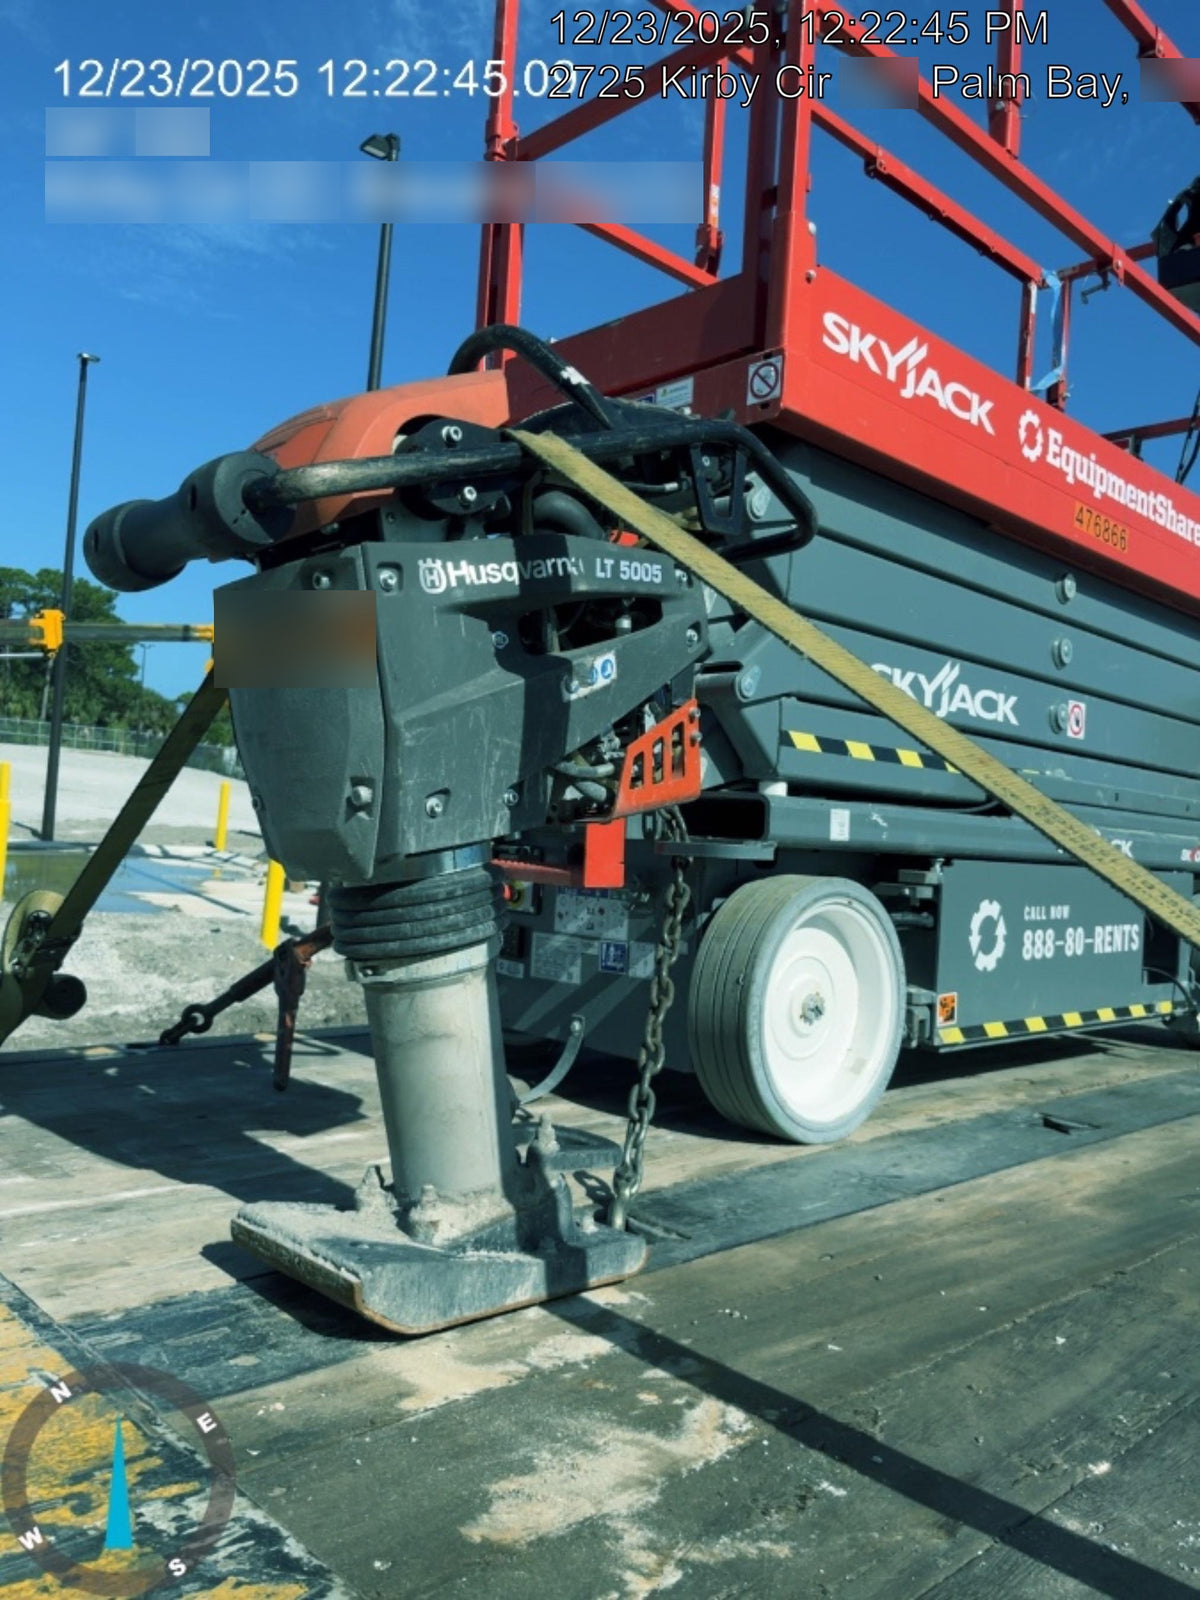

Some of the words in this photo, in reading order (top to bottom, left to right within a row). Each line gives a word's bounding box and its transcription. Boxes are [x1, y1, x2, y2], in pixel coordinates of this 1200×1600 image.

[822, 311, 996, 436] SKYJACK
[1075, 505, 1127, 551] 476866
[596, 557, 615, 578] LT
[620, 559, 662, 583] 5005
[1023, 904, 1047, 921] CALL
[1049, 904, 1070, 920] NOW
[1021, 923, 1140, 961] 888-80-RENTS
